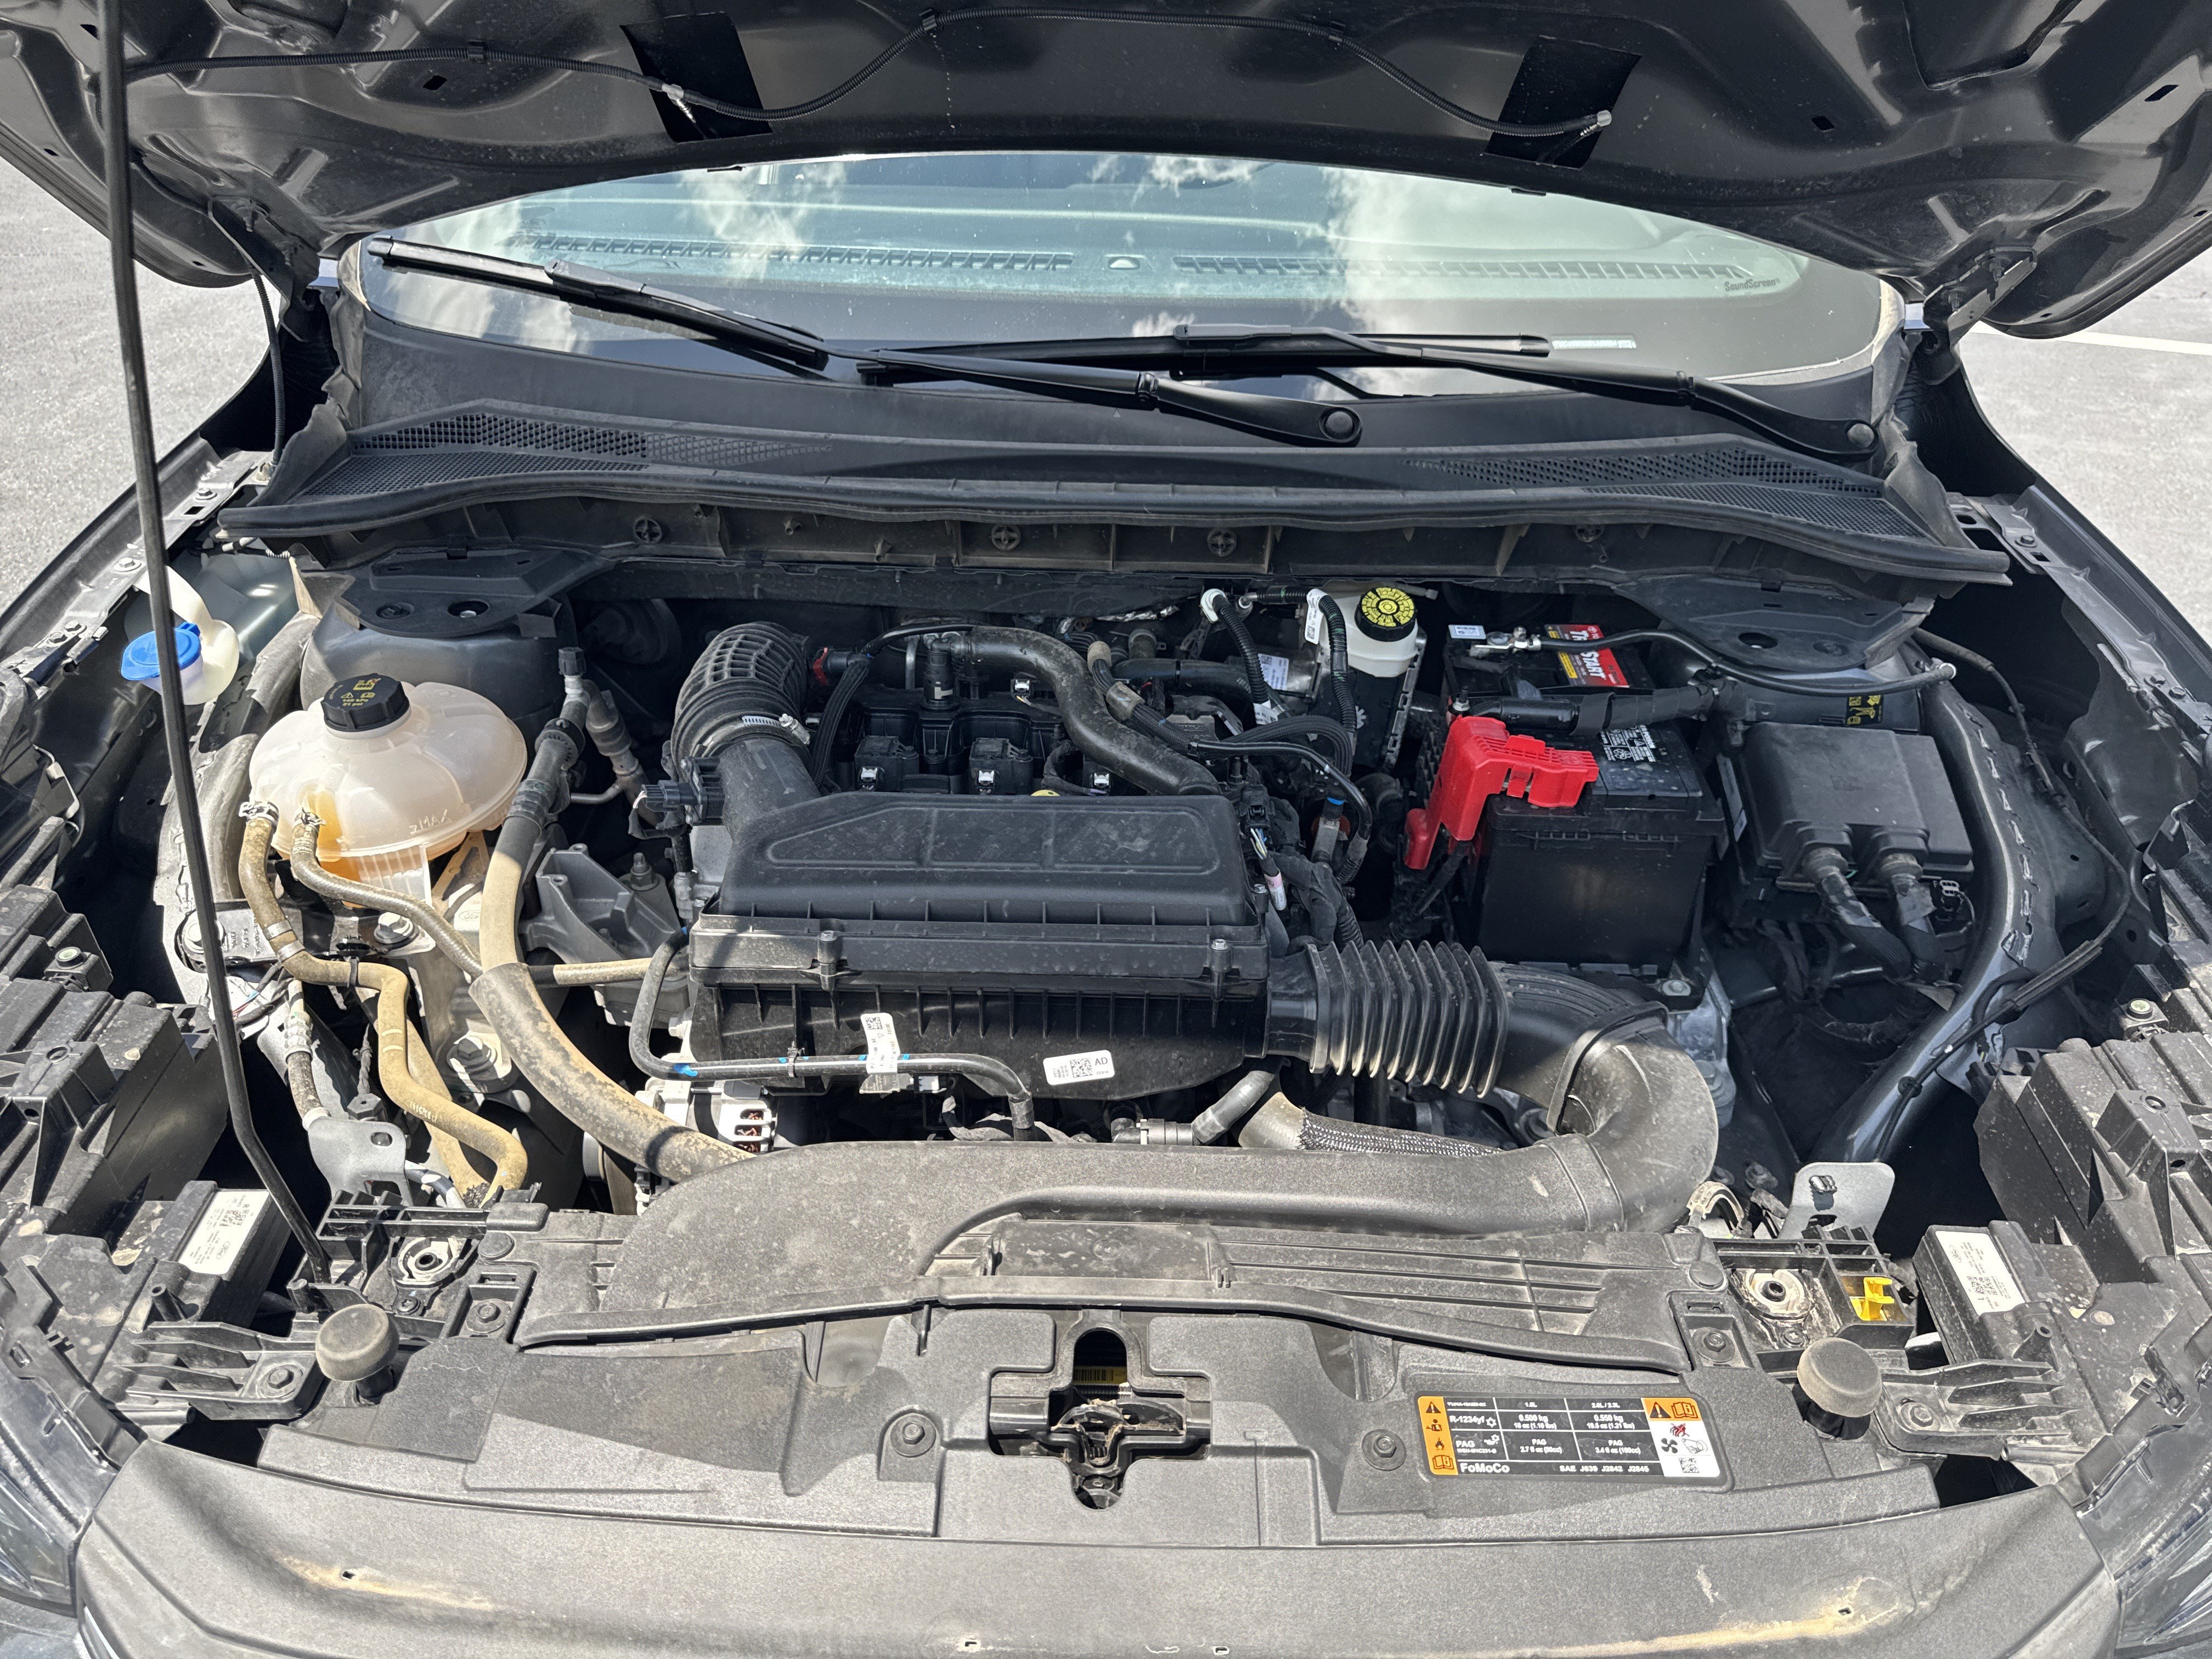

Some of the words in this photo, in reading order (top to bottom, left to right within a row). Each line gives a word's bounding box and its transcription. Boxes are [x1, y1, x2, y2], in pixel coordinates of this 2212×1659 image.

[1094, 1057, 1108, 1066] AD
[1449, 1415, 1485, 1425] R-1234yf
[1538, 1414, 1549, 1423] kg
[1613, 1414, 1624, 1423] kg
[1460, 1463, 1510, 1473] FoMoCo
